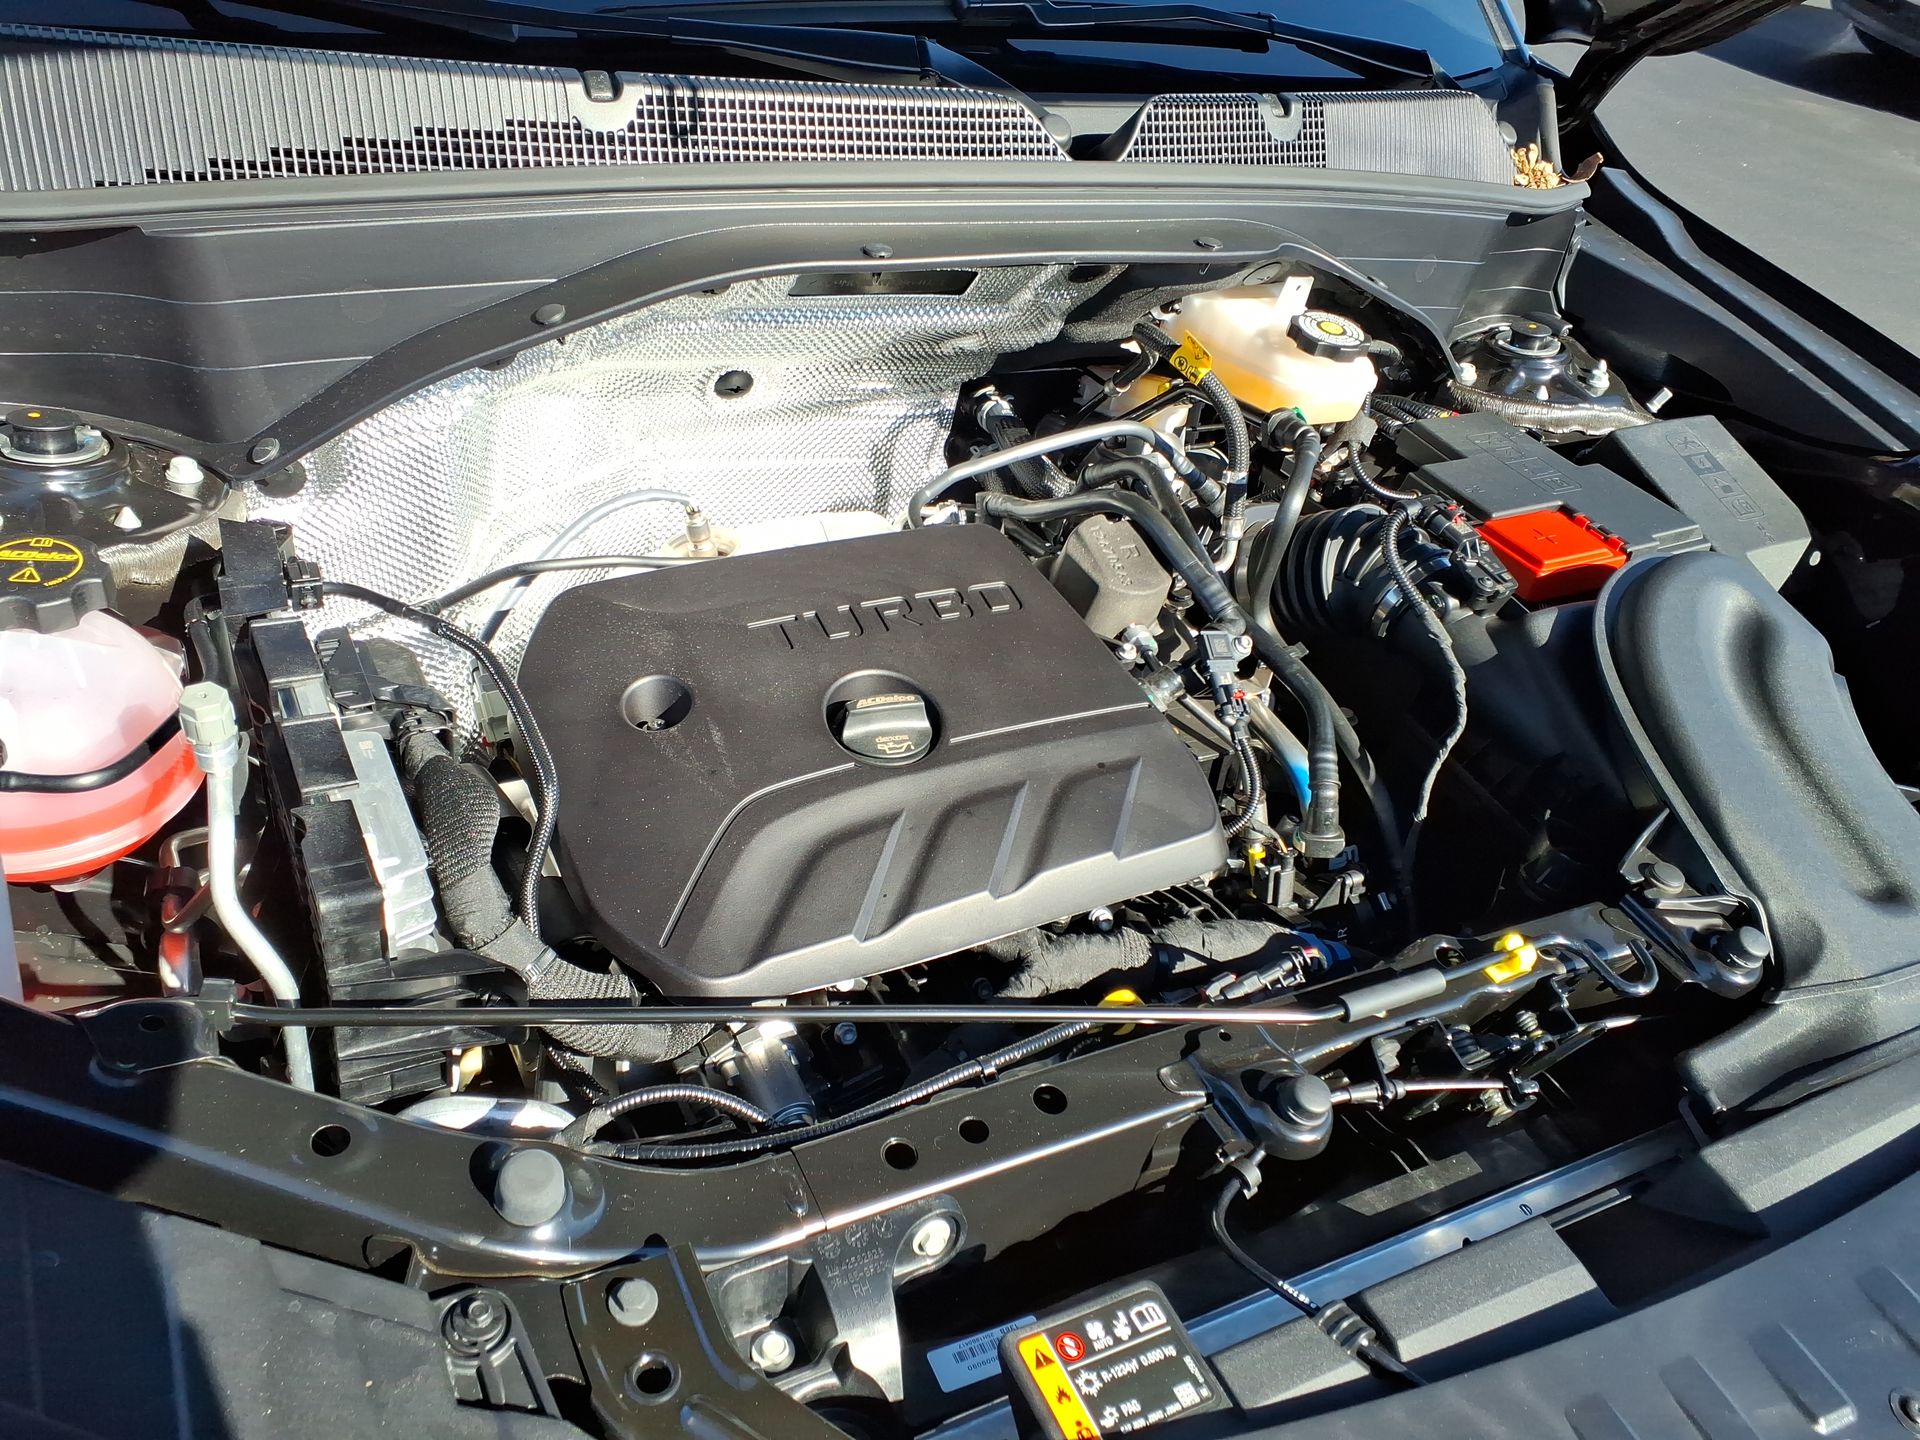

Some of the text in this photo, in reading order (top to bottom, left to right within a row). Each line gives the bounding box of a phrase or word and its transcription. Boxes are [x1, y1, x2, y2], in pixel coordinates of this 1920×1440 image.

[747, 580, 1024, 649] TURBO
[856, 694, 916, 709] ACDelco
[875, 735, 910, 743] dexos
[851, 1280, 872, 1298] RH
[1091, 1335, 1114, 1352] AUTO
[1162, 1344, 1177, 1358] kg
[1119, 1398, 1143, 1418] PAG
